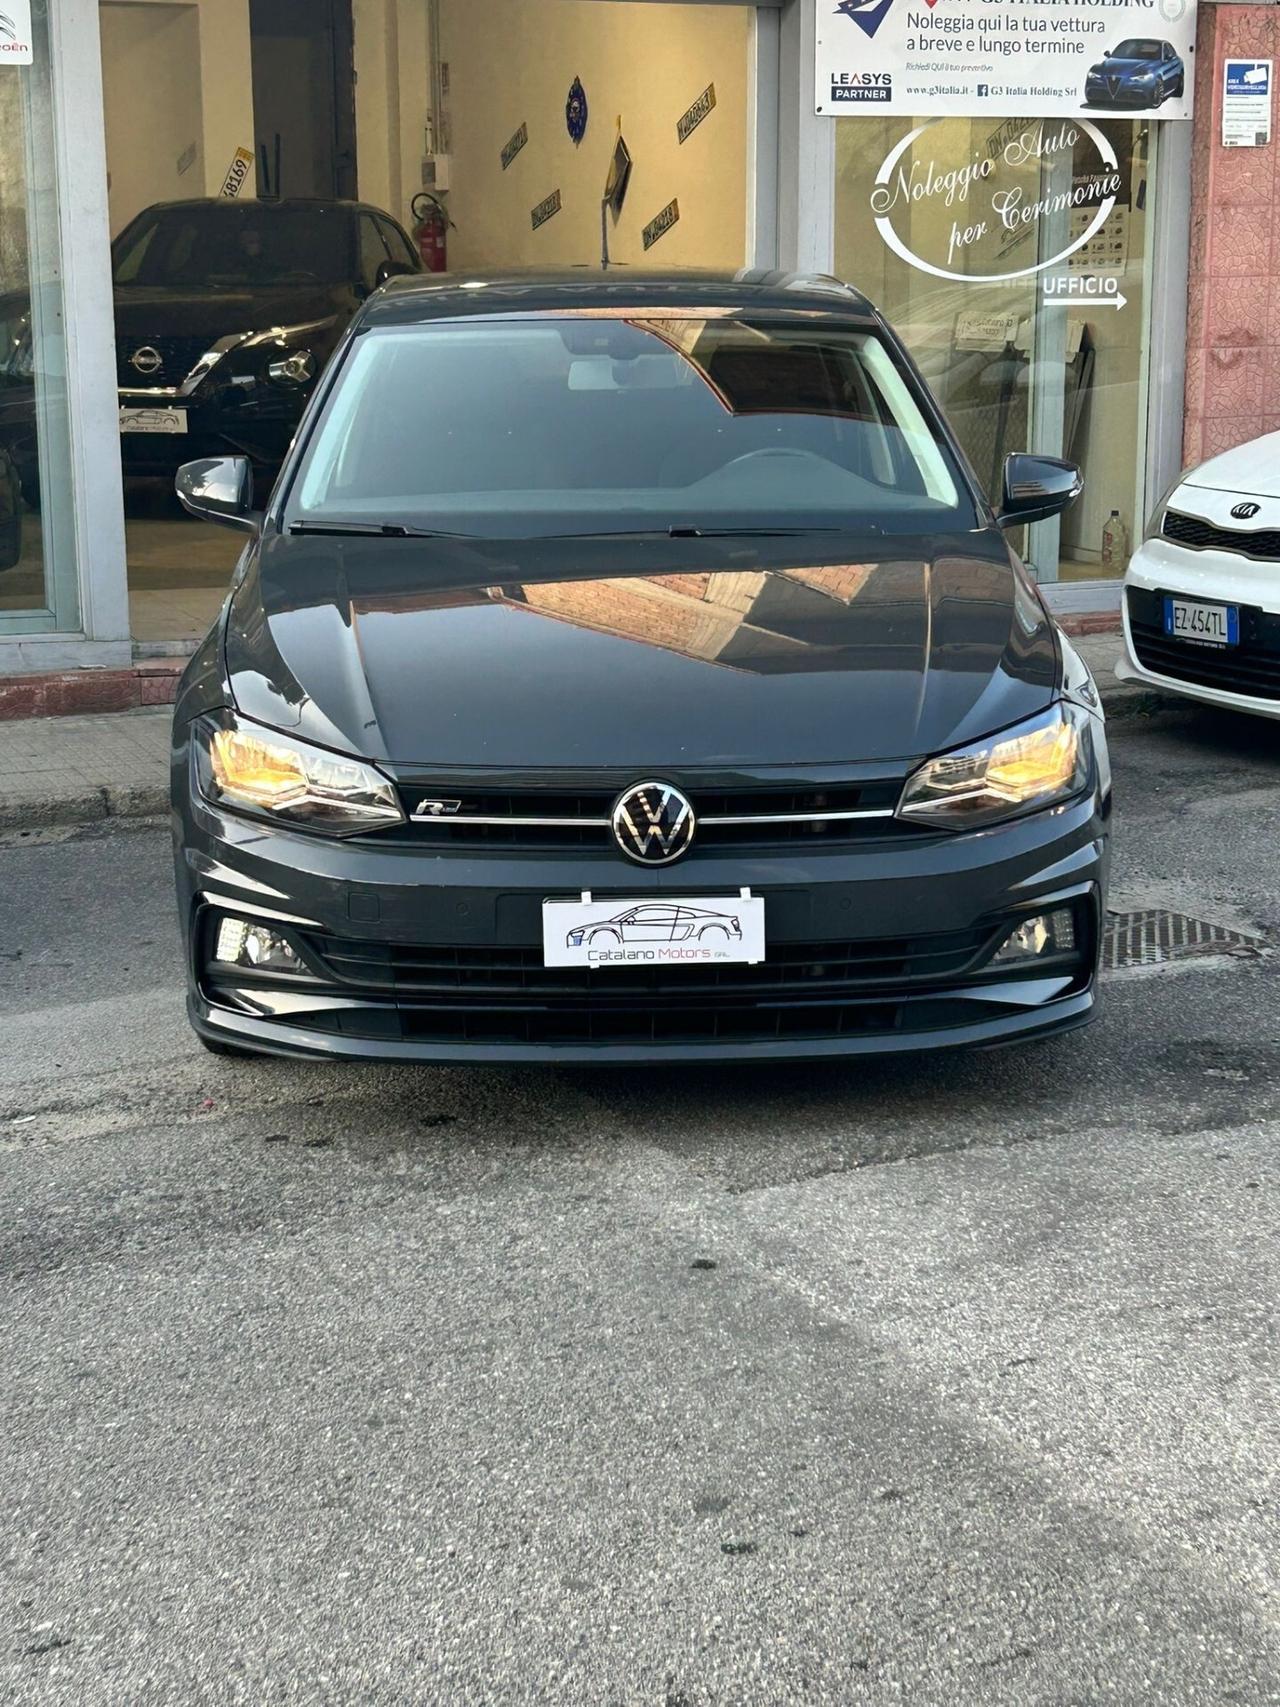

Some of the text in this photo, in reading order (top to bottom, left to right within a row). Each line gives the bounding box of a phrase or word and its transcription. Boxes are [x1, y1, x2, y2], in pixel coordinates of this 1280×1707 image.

[907, 13, 1105, 33] Noleggia qui la tua vettura
[906, 35, 1085, 56] a breve e lungo termine
[831, 72, 892, 85] LEASYS
[836, 89, 887, 99] PARTNER
[990, 86, 1003, 96] G3
[1006, 86, 1028, 96] Italia
[1030, 86, 1063, 97] Holding
[1064, 87, 1077, 97] Srl
[871, 119, 1080, 213] Noleggio Auto
[947, 167, 1122, 265] per Cerimonie
[1043, 277, 1118, 294] UFFICIO
[587, 949, 655, 961] Catalano
[658, 947, 711, 959] Motors
